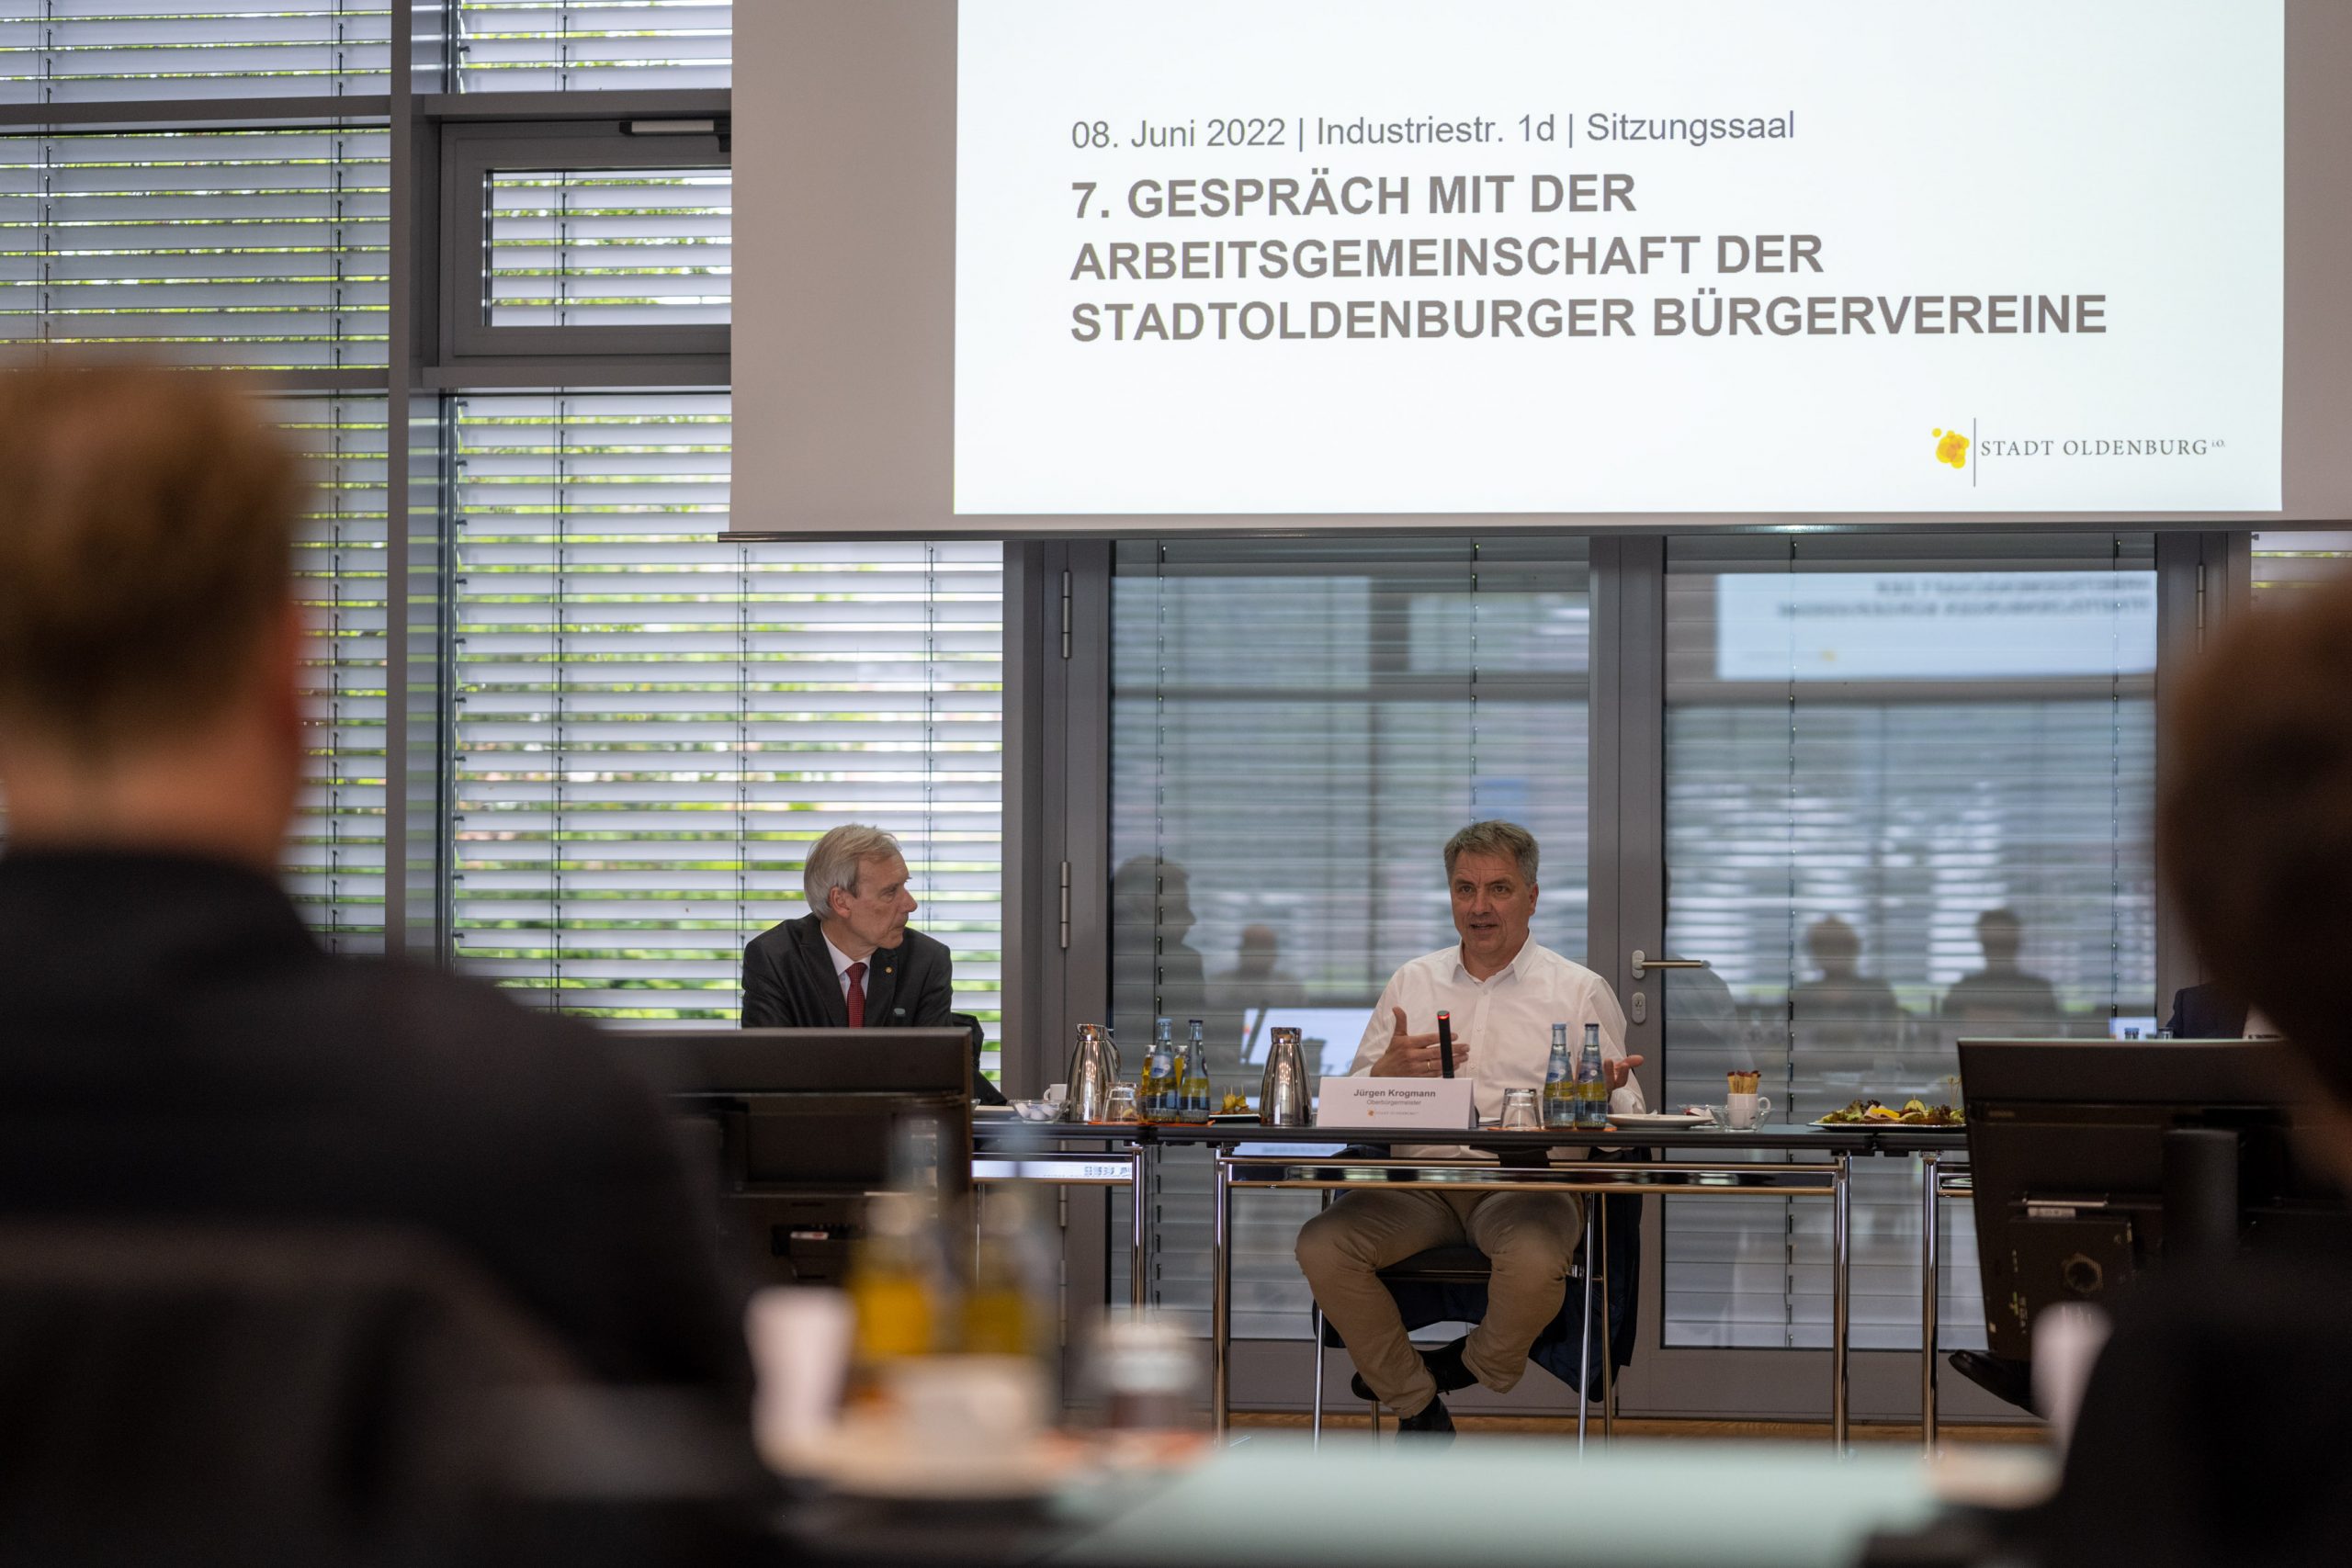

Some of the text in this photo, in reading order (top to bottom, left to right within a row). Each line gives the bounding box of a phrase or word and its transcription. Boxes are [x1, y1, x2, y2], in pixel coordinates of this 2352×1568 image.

[1072, 120, 1118, 148] 08.
[1131, 119, 1194, 148] Juni
[1206, 118, 1285, 147] 2022
[1318, 116, 1503, 145] Industriestr.
[1519, 114, 1555, 141] 1d
[1587, 109, 1794, 147] Sitzungssaal
[1071, 168, 1637, 219] 7. GESPRÄCH MIT DER
[1070, 234, 1825, 280] ARBEITSGEMEINSCHAFT DER
[1070, 287, 2107, 343] STADTOLDENBURGER BÜRGERVEREINE
[1981, 440, 2054, 457] STADT
[2063, 439, 2208, 456] OLDENBURG
[1353, 1089, 1436, 1099] Jürgen Krogmann
